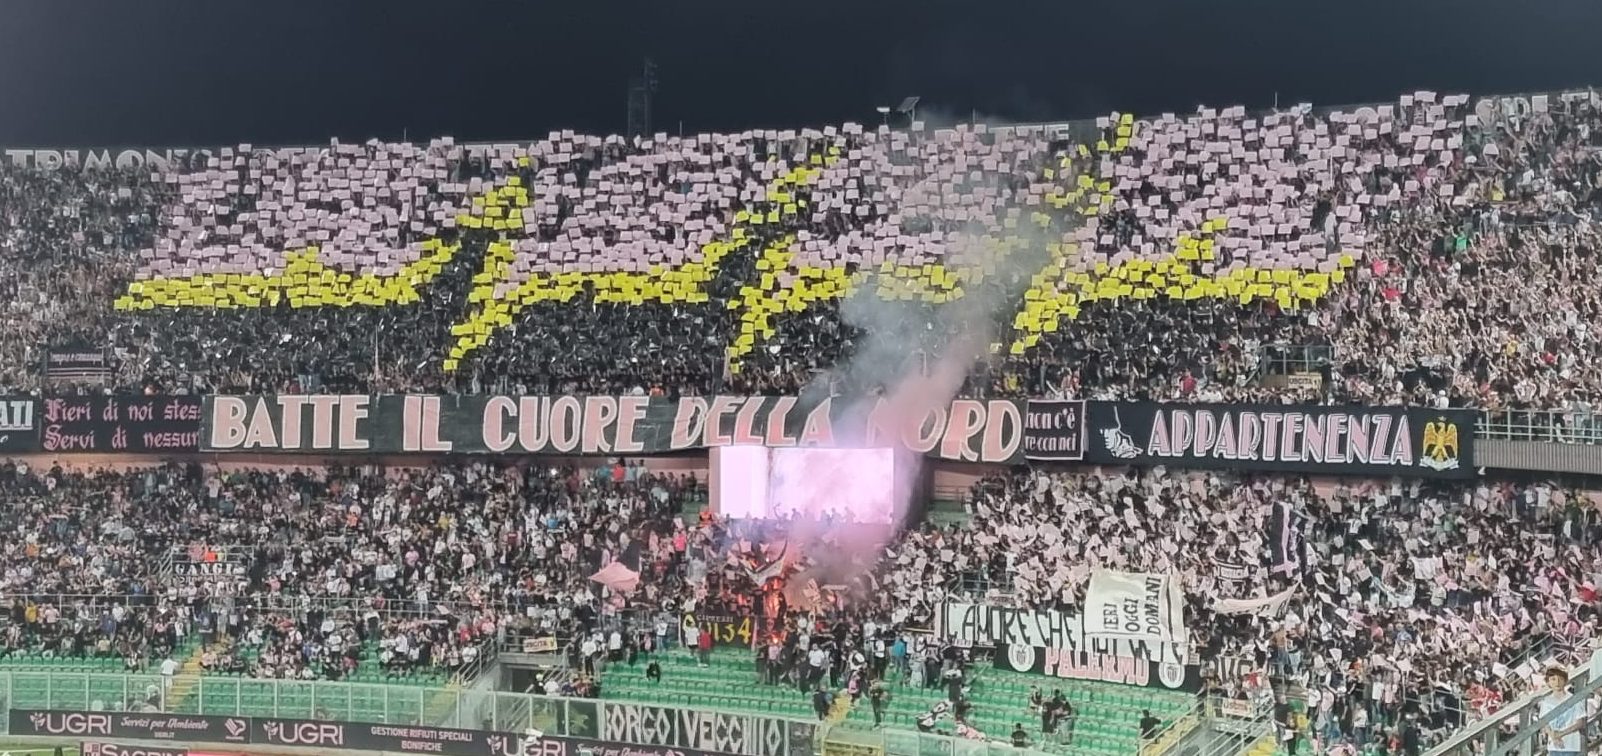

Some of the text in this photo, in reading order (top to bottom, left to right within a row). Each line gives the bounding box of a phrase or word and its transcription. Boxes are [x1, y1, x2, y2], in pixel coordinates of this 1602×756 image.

[102, 398, 118, 421] di
[128, 402, 153, 421] noi
[211, 394, 370, 449] BATTE
[403, 396, 453, 451] IL
[483, 395, 649, 452] CUORE
[670, 395, 834, 448] DELLA
[43, 424, 95, 451] Servi
[111, 425, 127, 448] di
[1147, 409, 1413, 466] APPARTENENZA
[1102, 603, 1119, 630] IERI
[1123, 597, 1141, 632] OGGI
[1144, 576, 1161, 636] DOMANI
[1045, 646, 1149, 687] PALERMO
[47, 713, 112, 735] UGRI
[279, 723, 344, 745] UGRI
[370, 726, 408, 737] GESTIONE
[438, 731, 473, 742] SPECIALI
